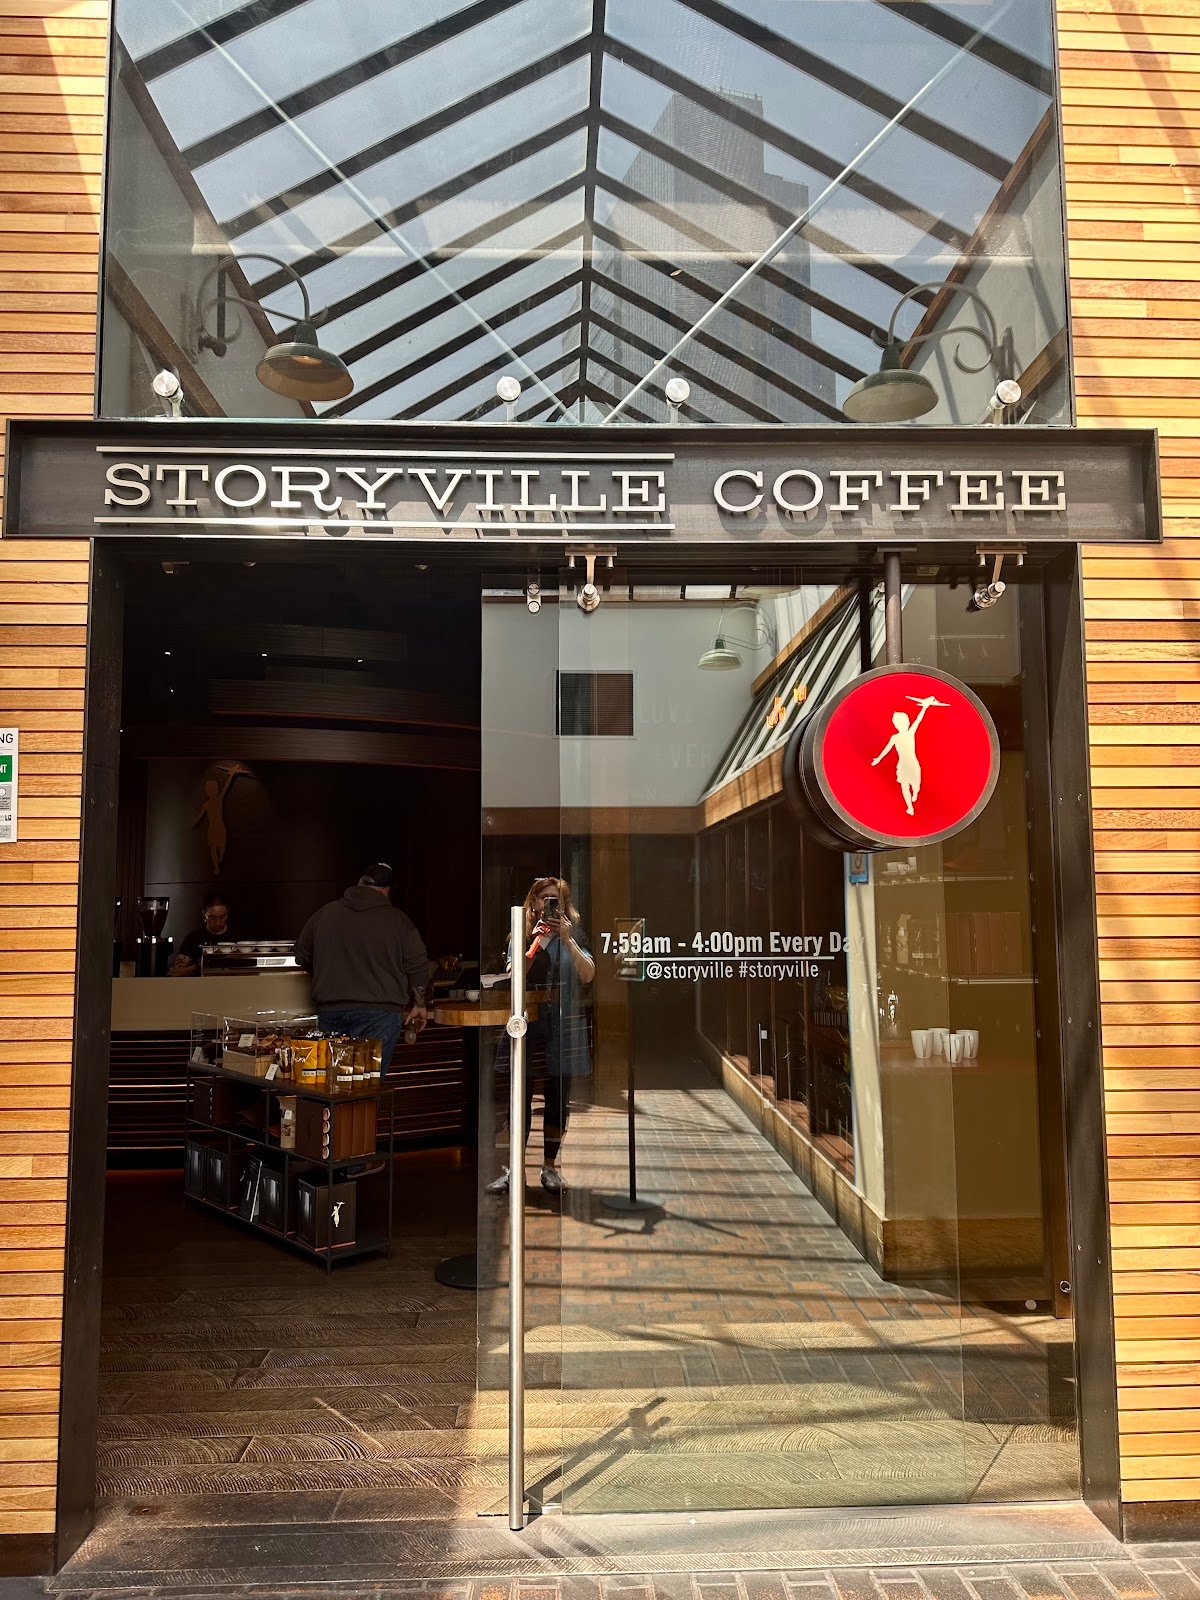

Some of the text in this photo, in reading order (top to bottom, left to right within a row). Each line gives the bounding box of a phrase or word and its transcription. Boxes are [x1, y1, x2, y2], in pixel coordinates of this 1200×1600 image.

[103, 463, 1067, 514] STORYVILLE COFFEE
[600, 932, 671, 954] 7:59am
[692, 931, 763, 957] 4:00pm
[769, 931, 823, 957] Every
[646, 961, 819, 982] @storyville #storyville
